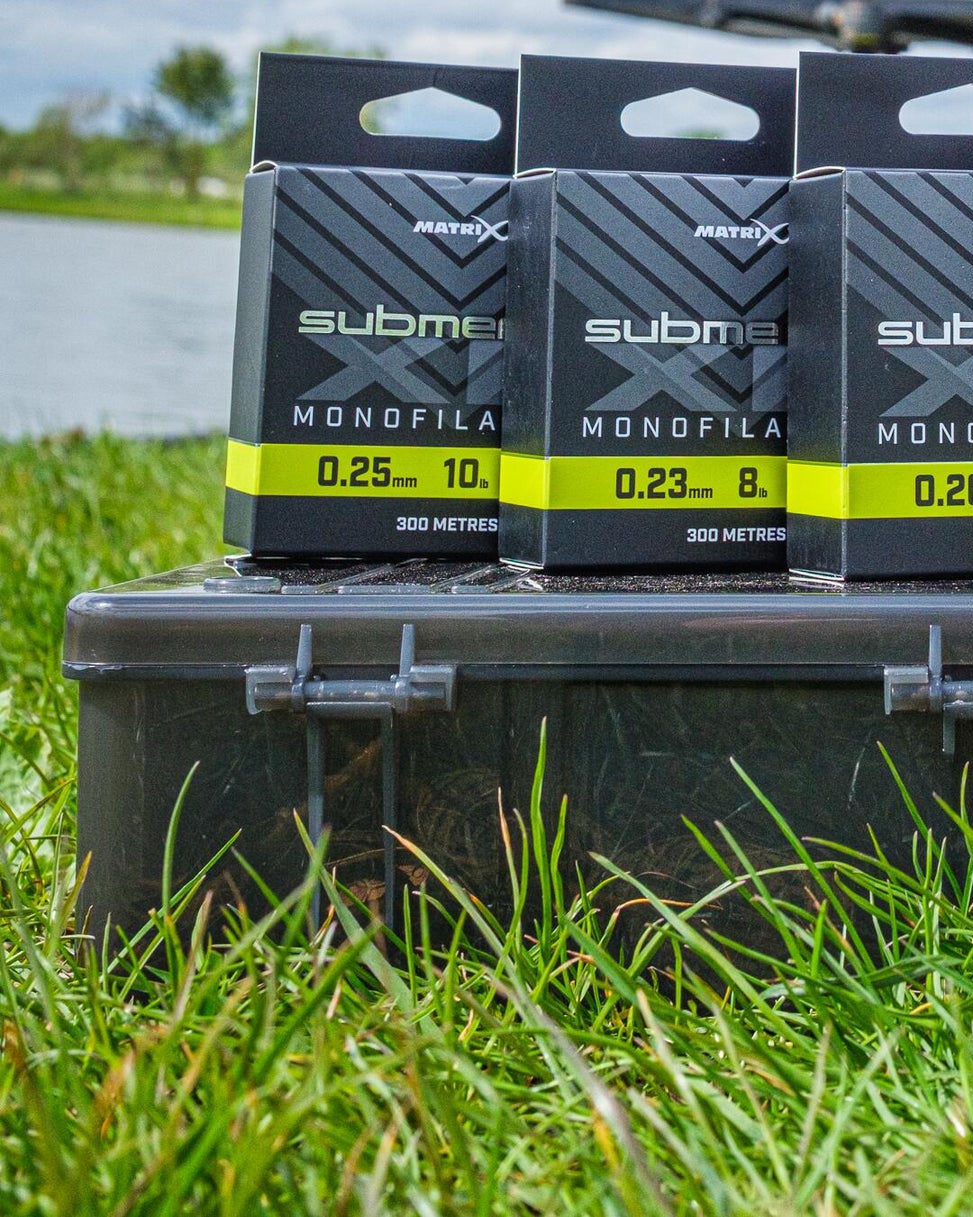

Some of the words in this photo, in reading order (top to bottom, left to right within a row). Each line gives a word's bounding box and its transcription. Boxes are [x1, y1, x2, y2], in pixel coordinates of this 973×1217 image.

[413, 215, 508, 243] MATRIX
[694, 218, 789, 246] MATRIX
[299, 304, 504, 339] subme
[293, 405, 496, 431] MONOFILA
[582, 417, 781, 438] MONOFILA
[318, 455, 417, 488] 0.25mm
[616, 467, 713, 499] 0.23mm
[396, 516, 429, 532] 300
[433, 517, 498, 532] METRES
[687, 528, 718, 542] 300
[723, 527, 786, 542] METRES
